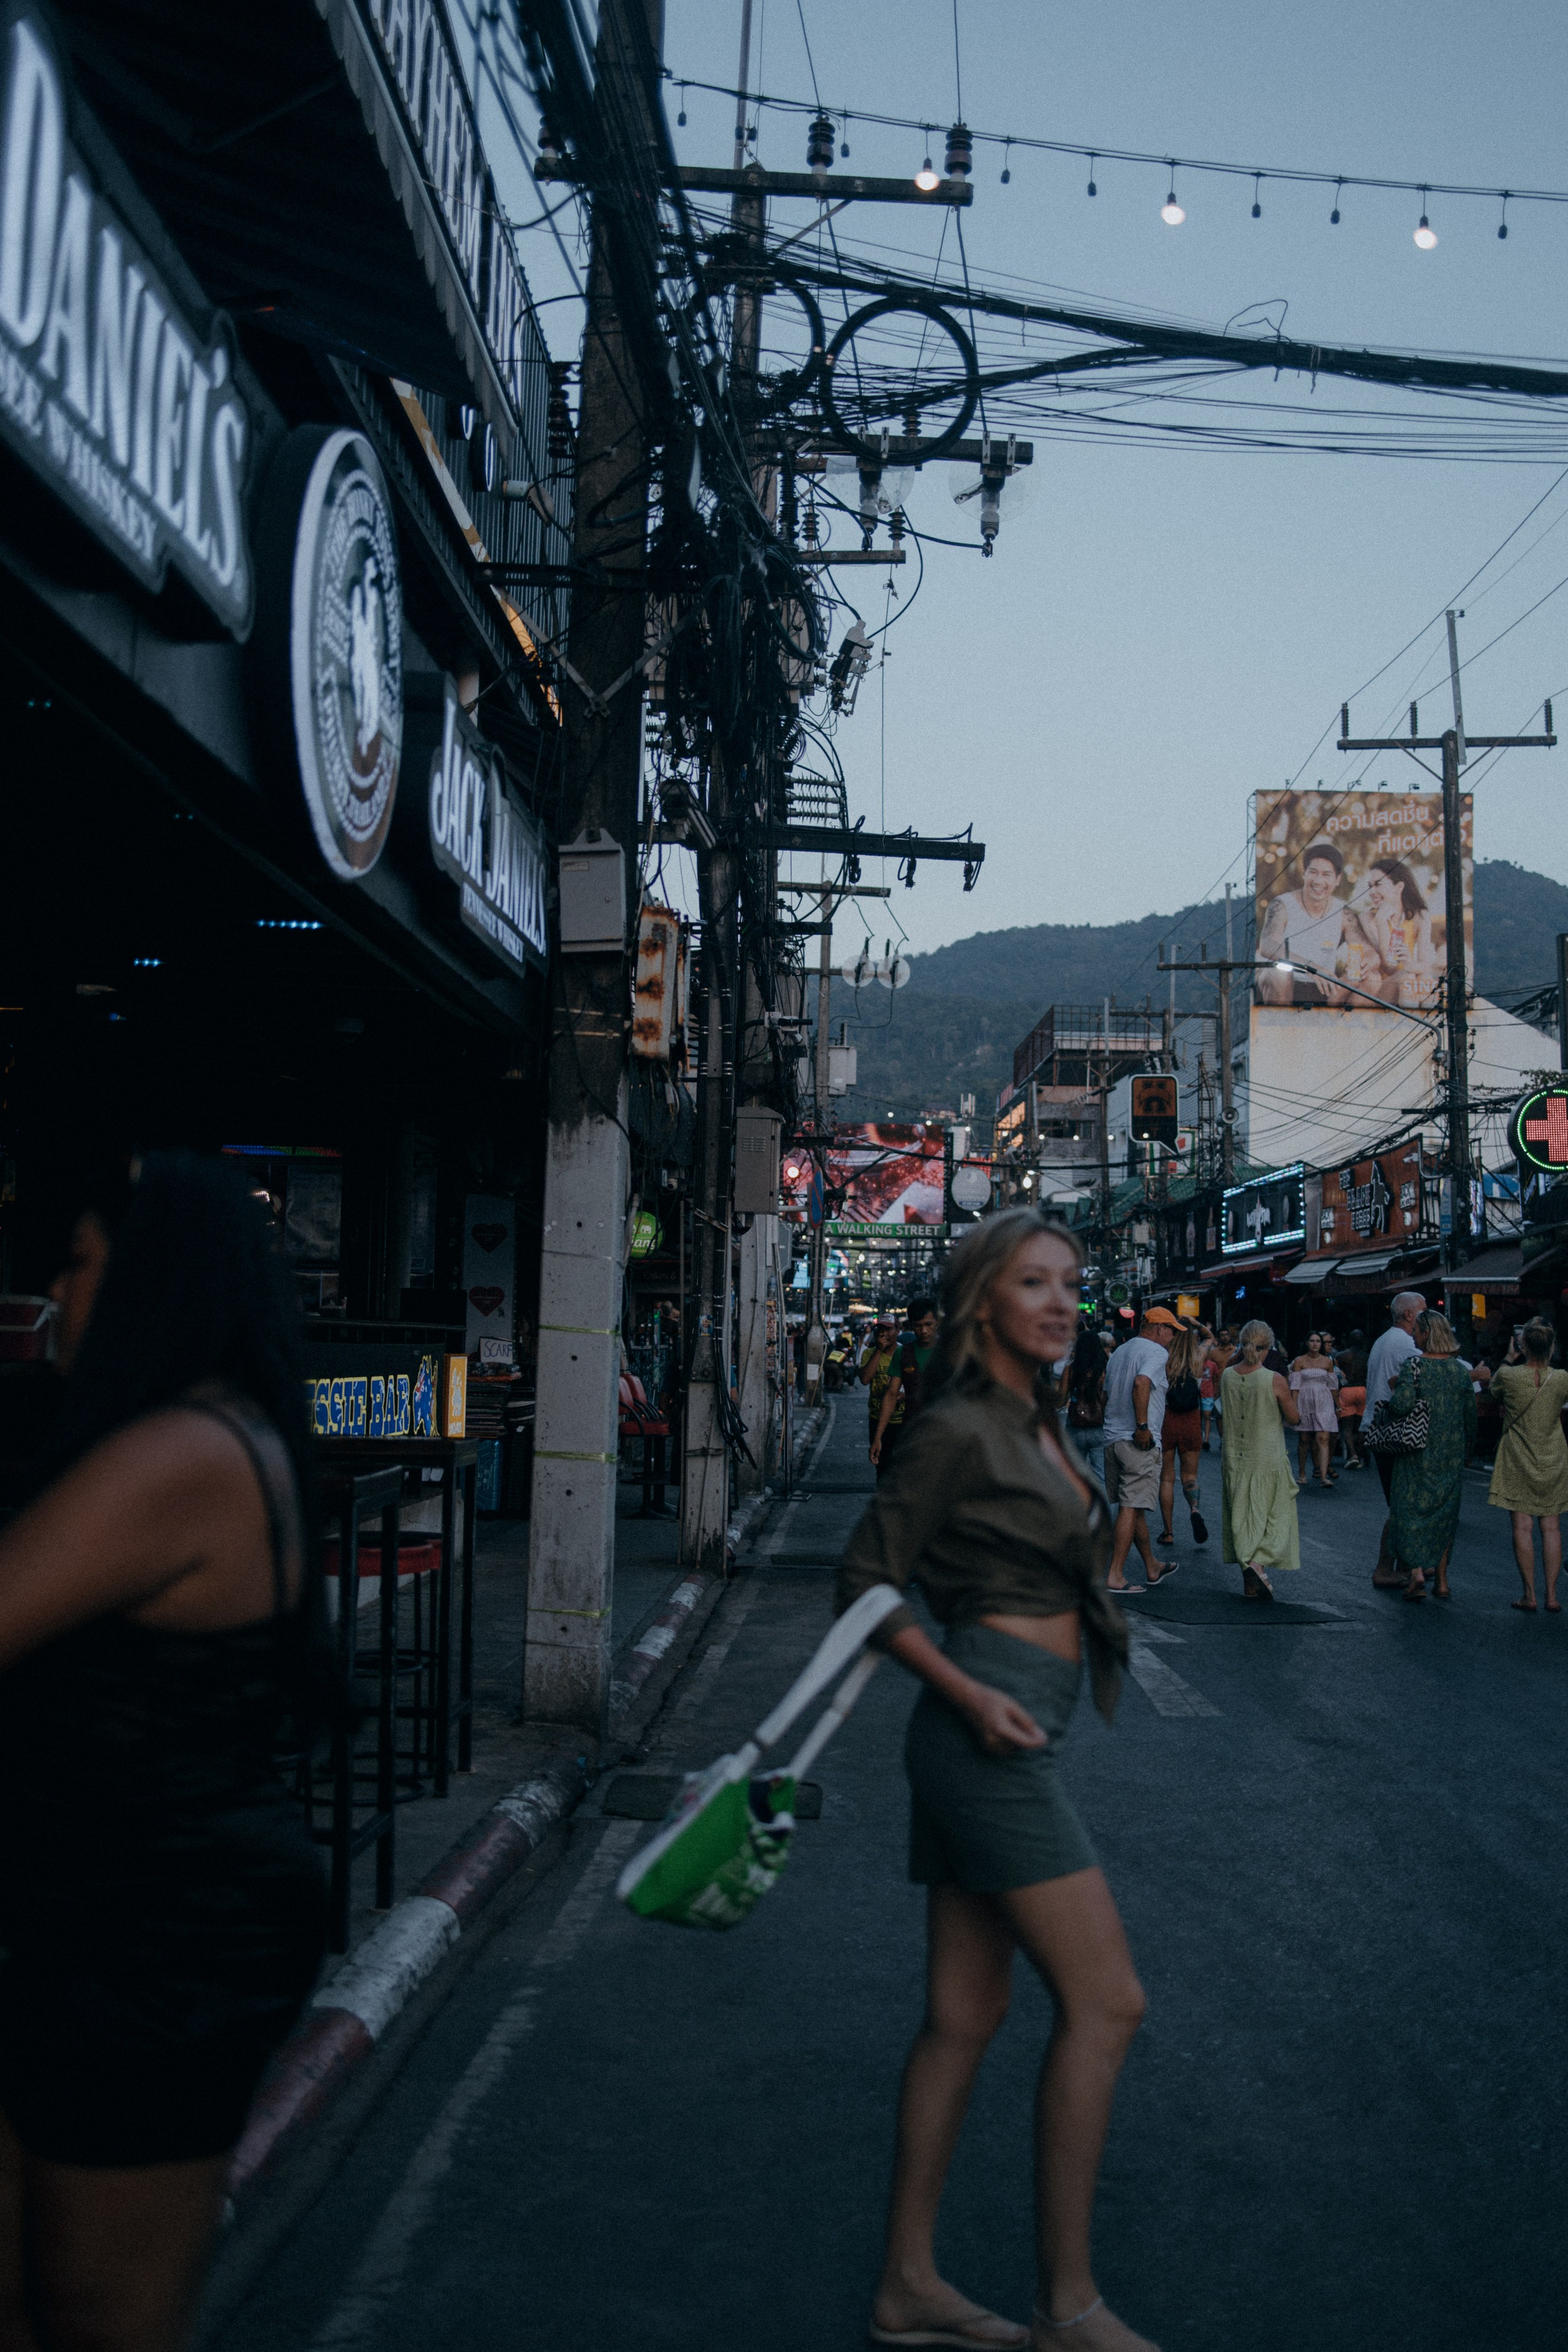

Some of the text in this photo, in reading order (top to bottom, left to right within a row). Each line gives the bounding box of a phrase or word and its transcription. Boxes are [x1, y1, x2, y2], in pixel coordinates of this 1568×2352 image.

[431, 697, 486, 888] JACK
[837, 1224, 893, 1235] WALKING
[895, 1225, 940, 1236] STREET
[369, 1374, 411, 1436] BAR
